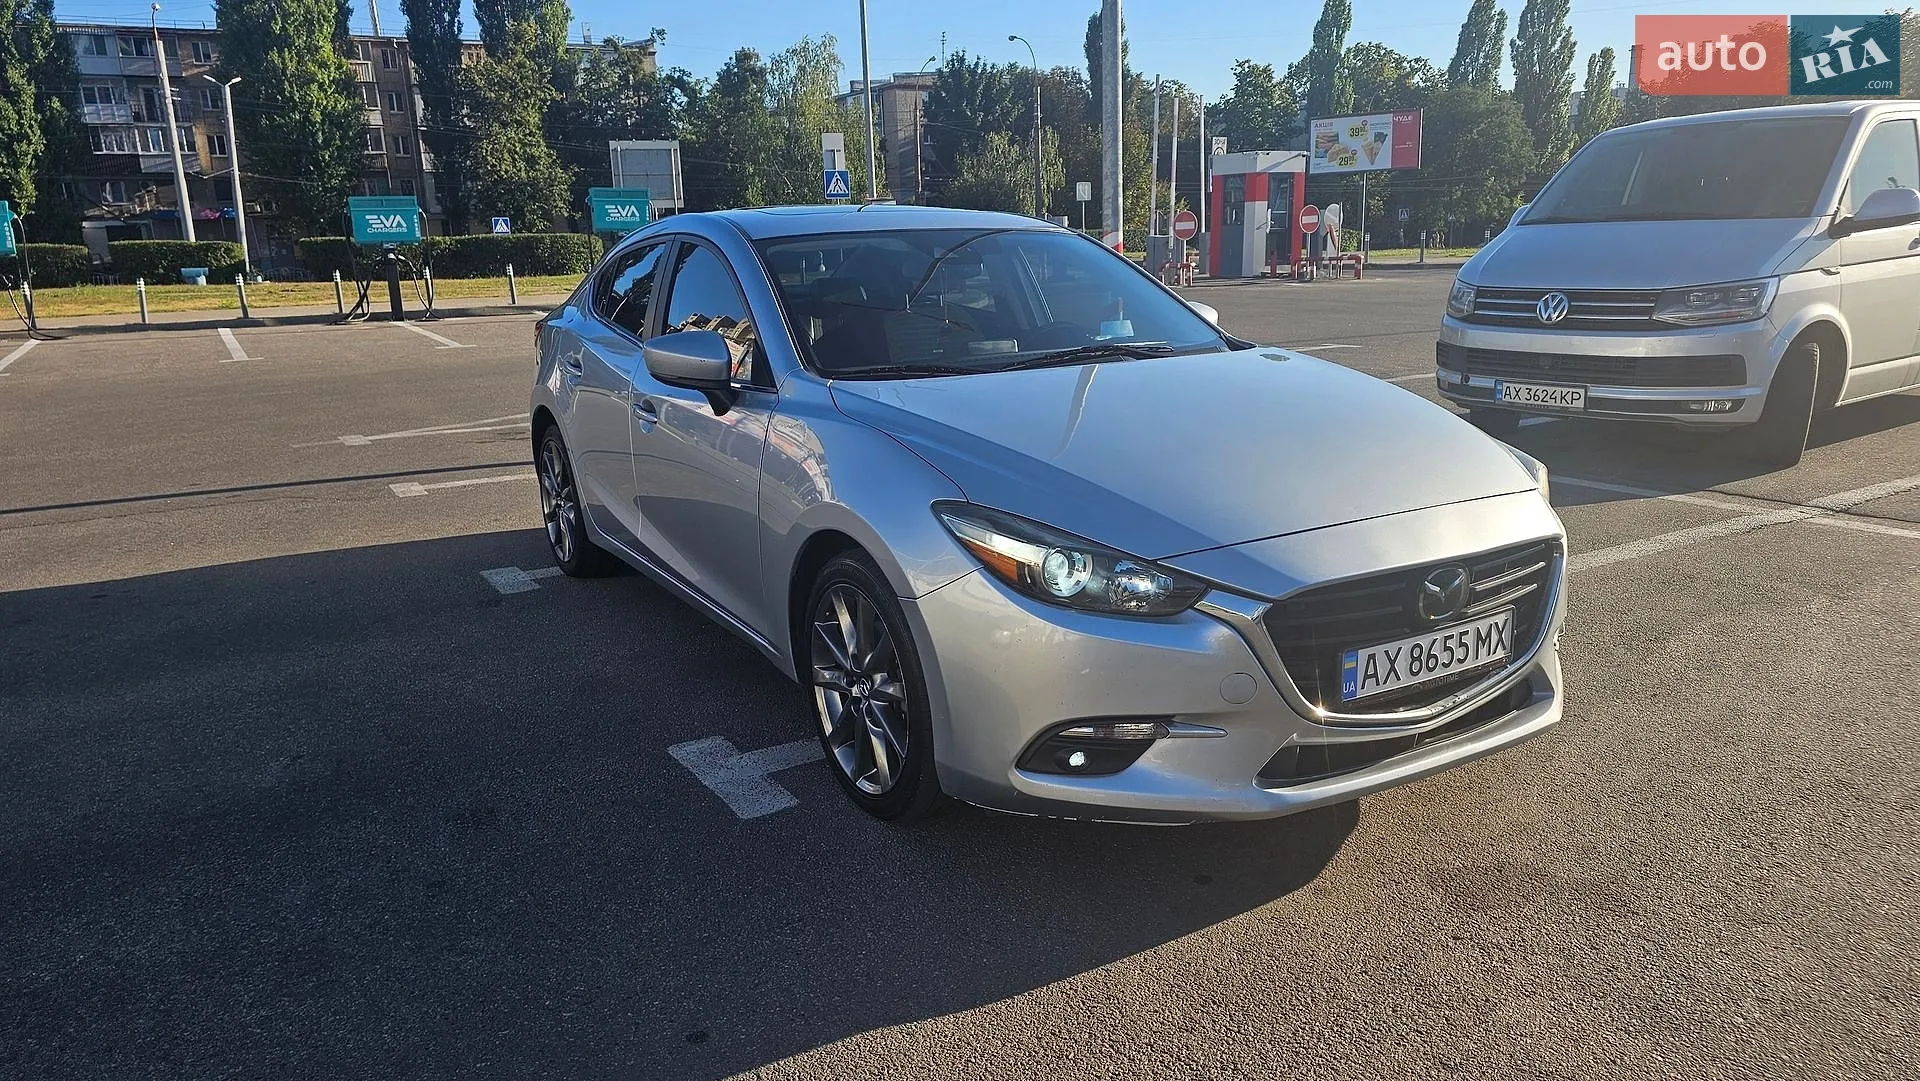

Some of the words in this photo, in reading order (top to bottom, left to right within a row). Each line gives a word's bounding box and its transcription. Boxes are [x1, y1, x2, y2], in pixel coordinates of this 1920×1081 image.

[605, 204, 640, 217] EVA
[365, 214, 407, 228] EVA
[1503, 386, 1522, 401] AX
[1525, 388, 1557, 404] 3624
[1560, 390, 1582, 405] KP
[1360, 646, 1403, 690] AX
[1408, 629, 1470, 677] 8655
[1475, 617, 1510, 661] MX
[1343, 682, 1356, 694] UA
